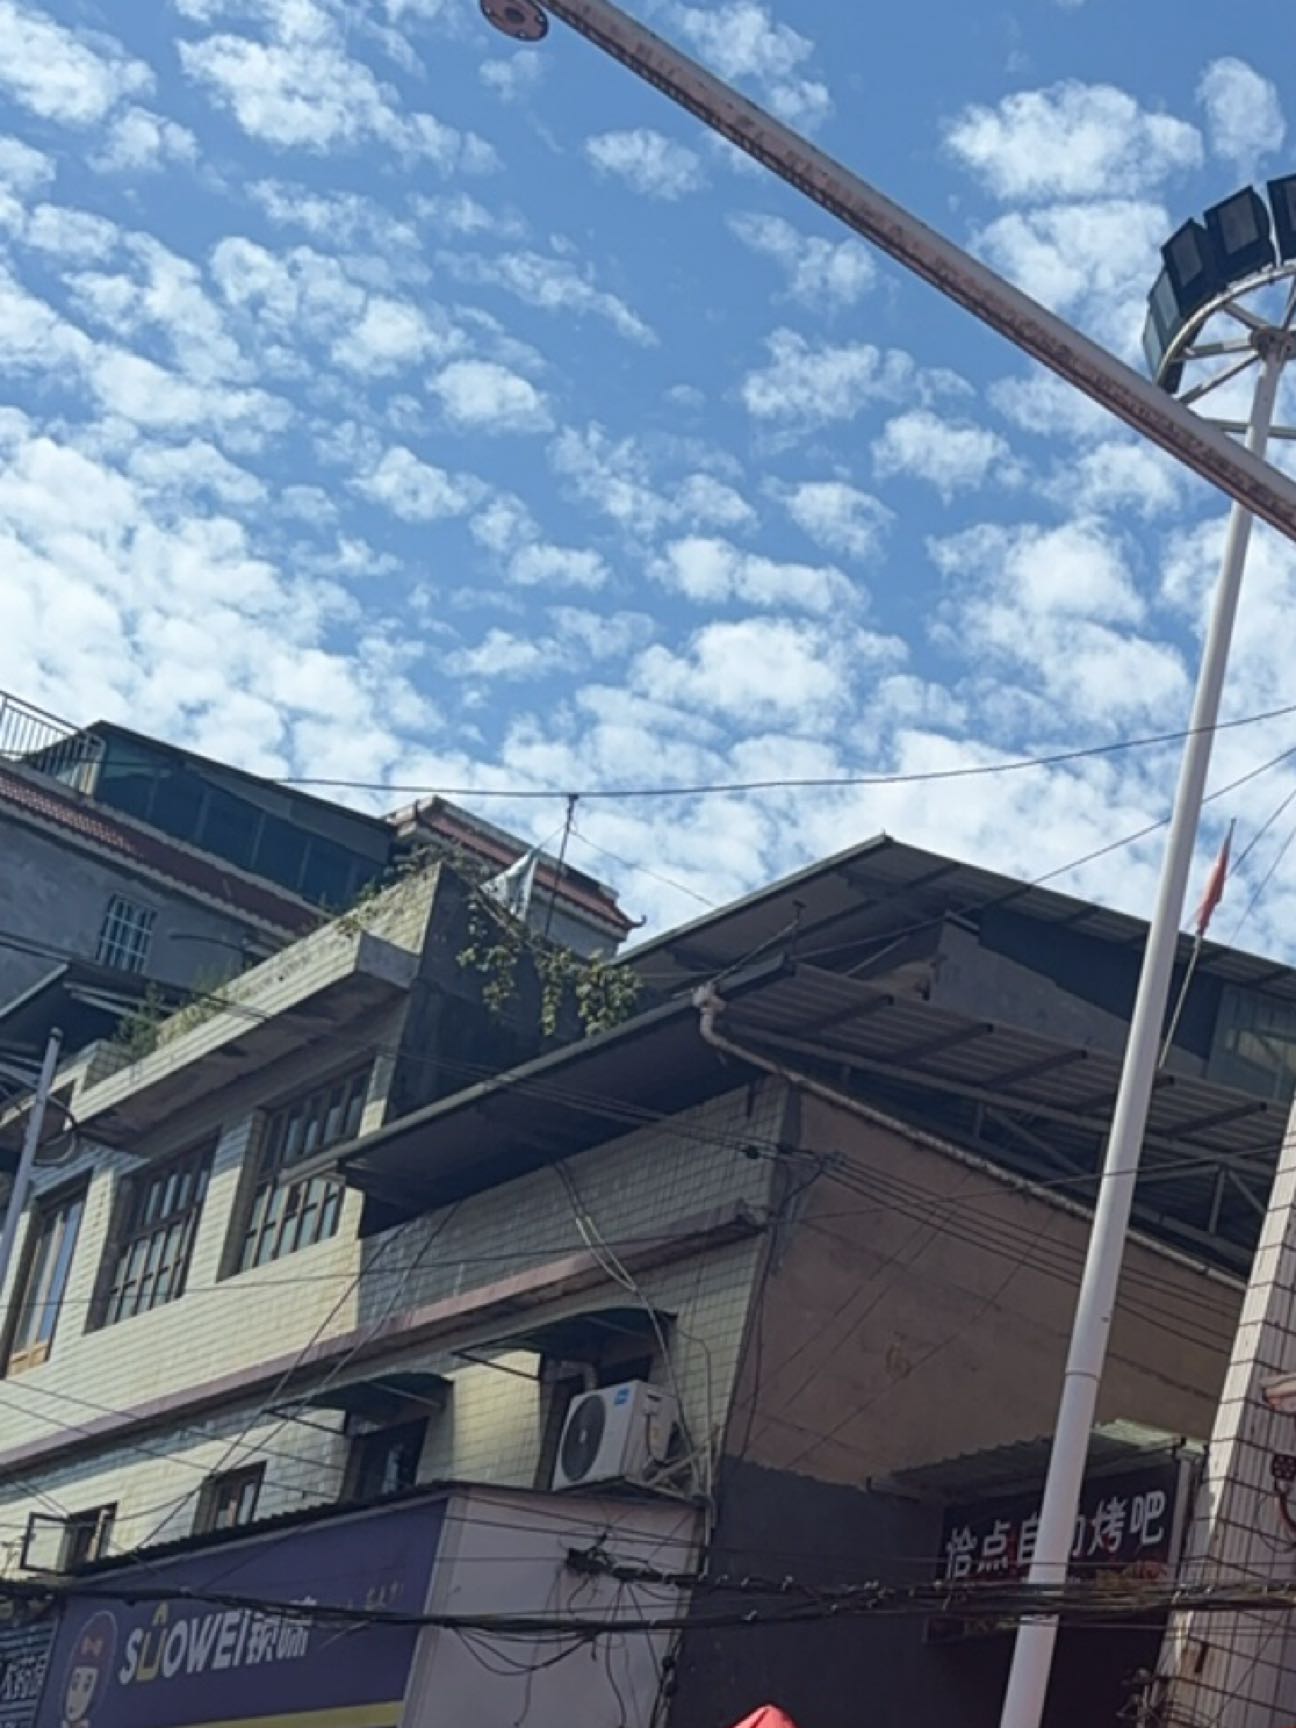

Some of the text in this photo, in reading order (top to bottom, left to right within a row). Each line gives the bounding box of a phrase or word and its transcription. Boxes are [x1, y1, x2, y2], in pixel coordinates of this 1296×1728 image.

[944, 1490, 1166, 1578] 怡点自烤吧
